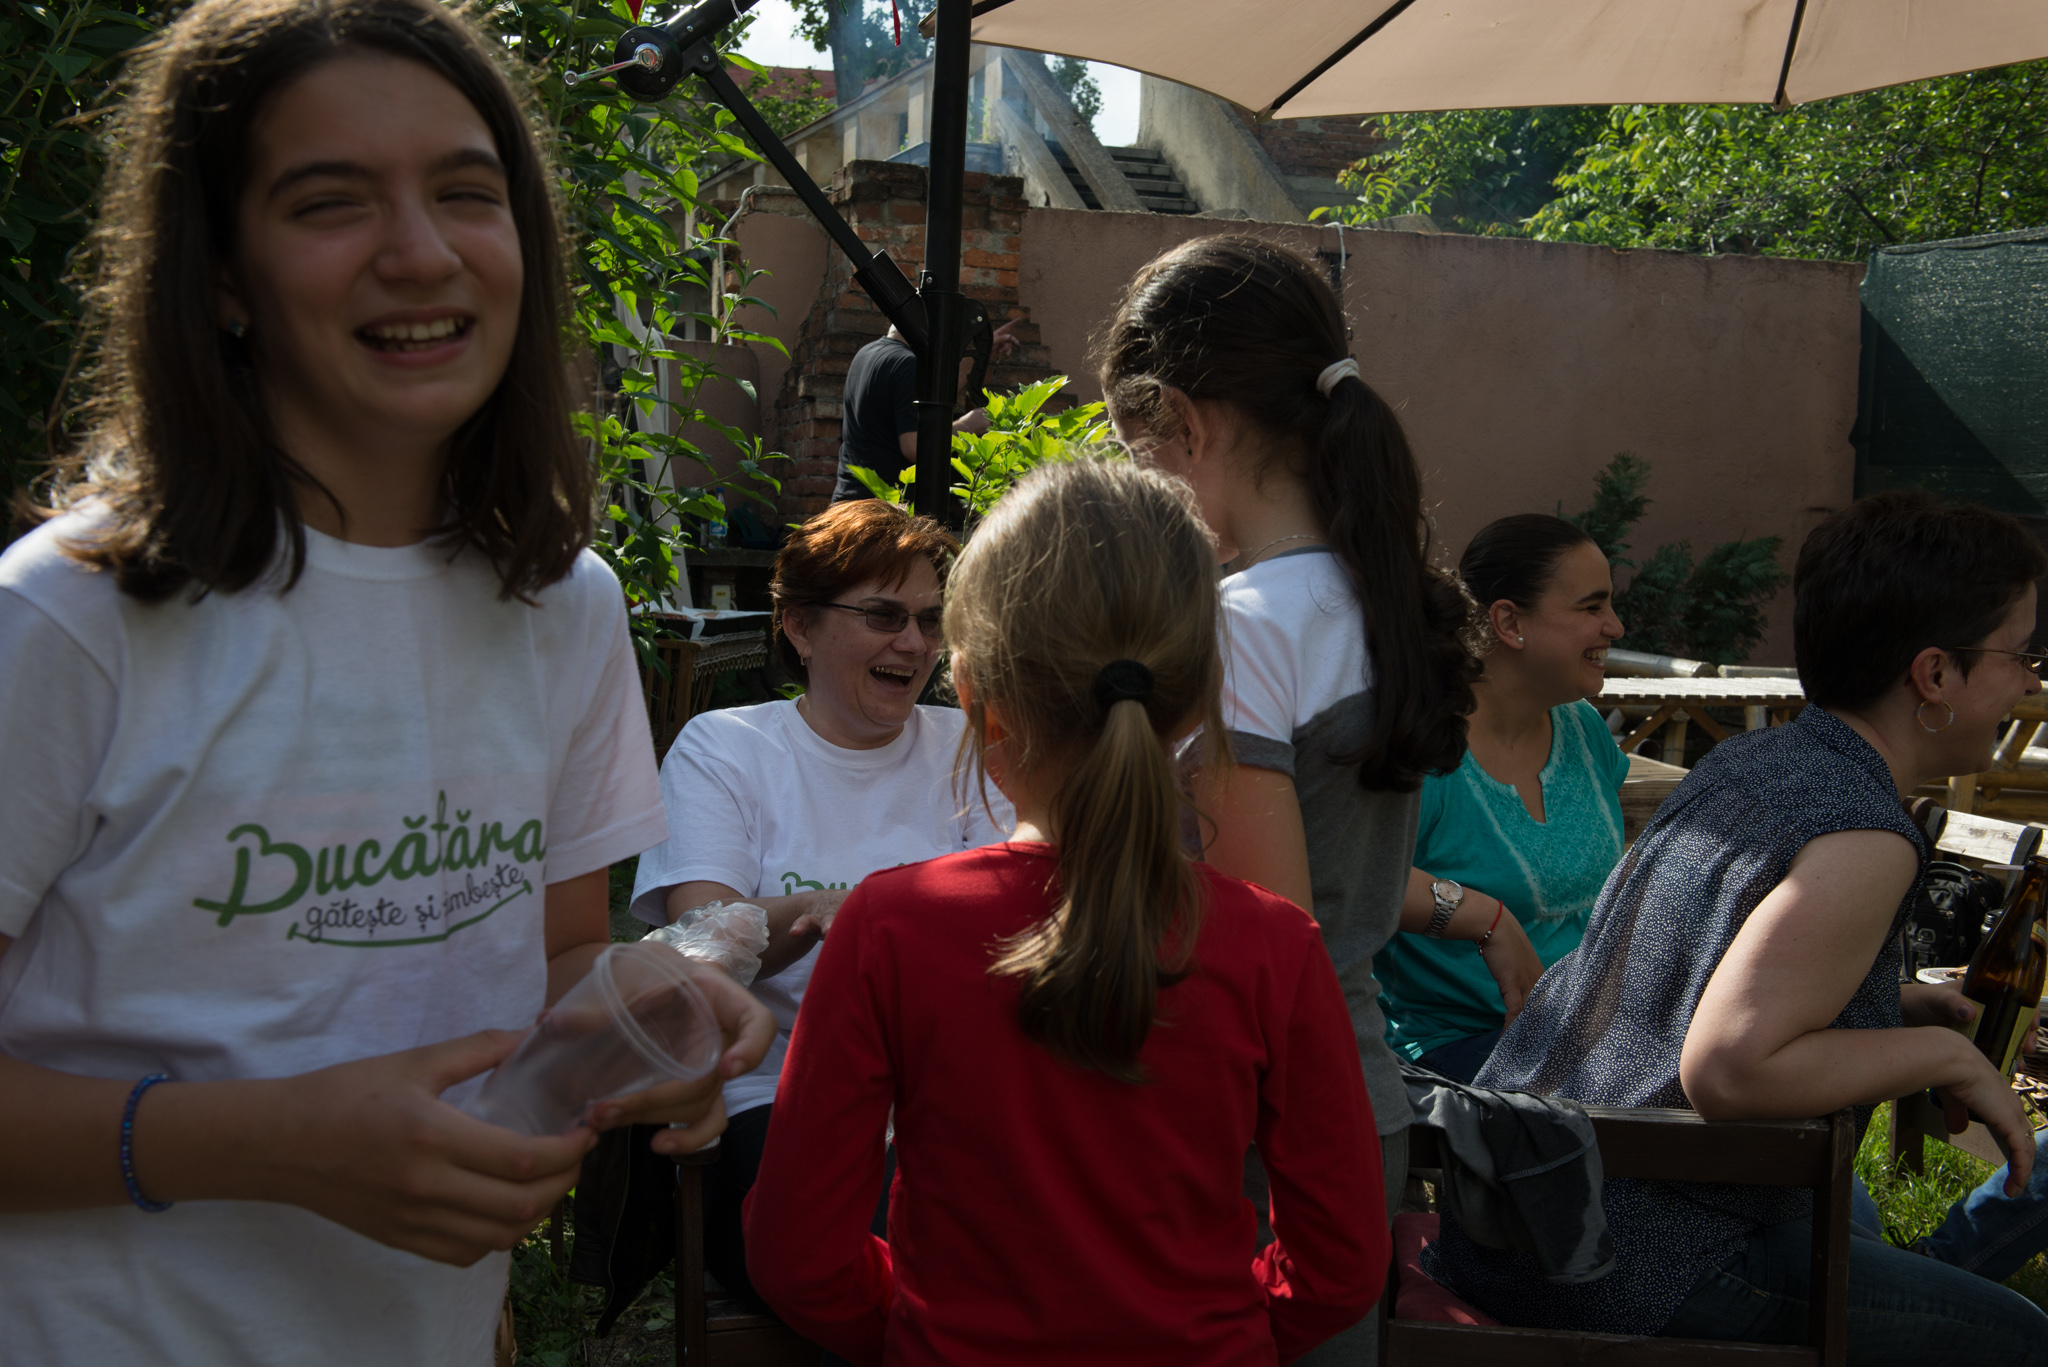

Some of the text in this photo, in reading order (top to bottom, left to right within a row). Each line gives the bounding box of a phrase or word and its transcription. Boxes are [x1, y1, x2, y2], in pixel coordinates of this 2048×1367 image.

[193, 789, 546, 927] Bucătăra
[305, 897, 407, 943] gătește
[414, 895, 441, 933] și
